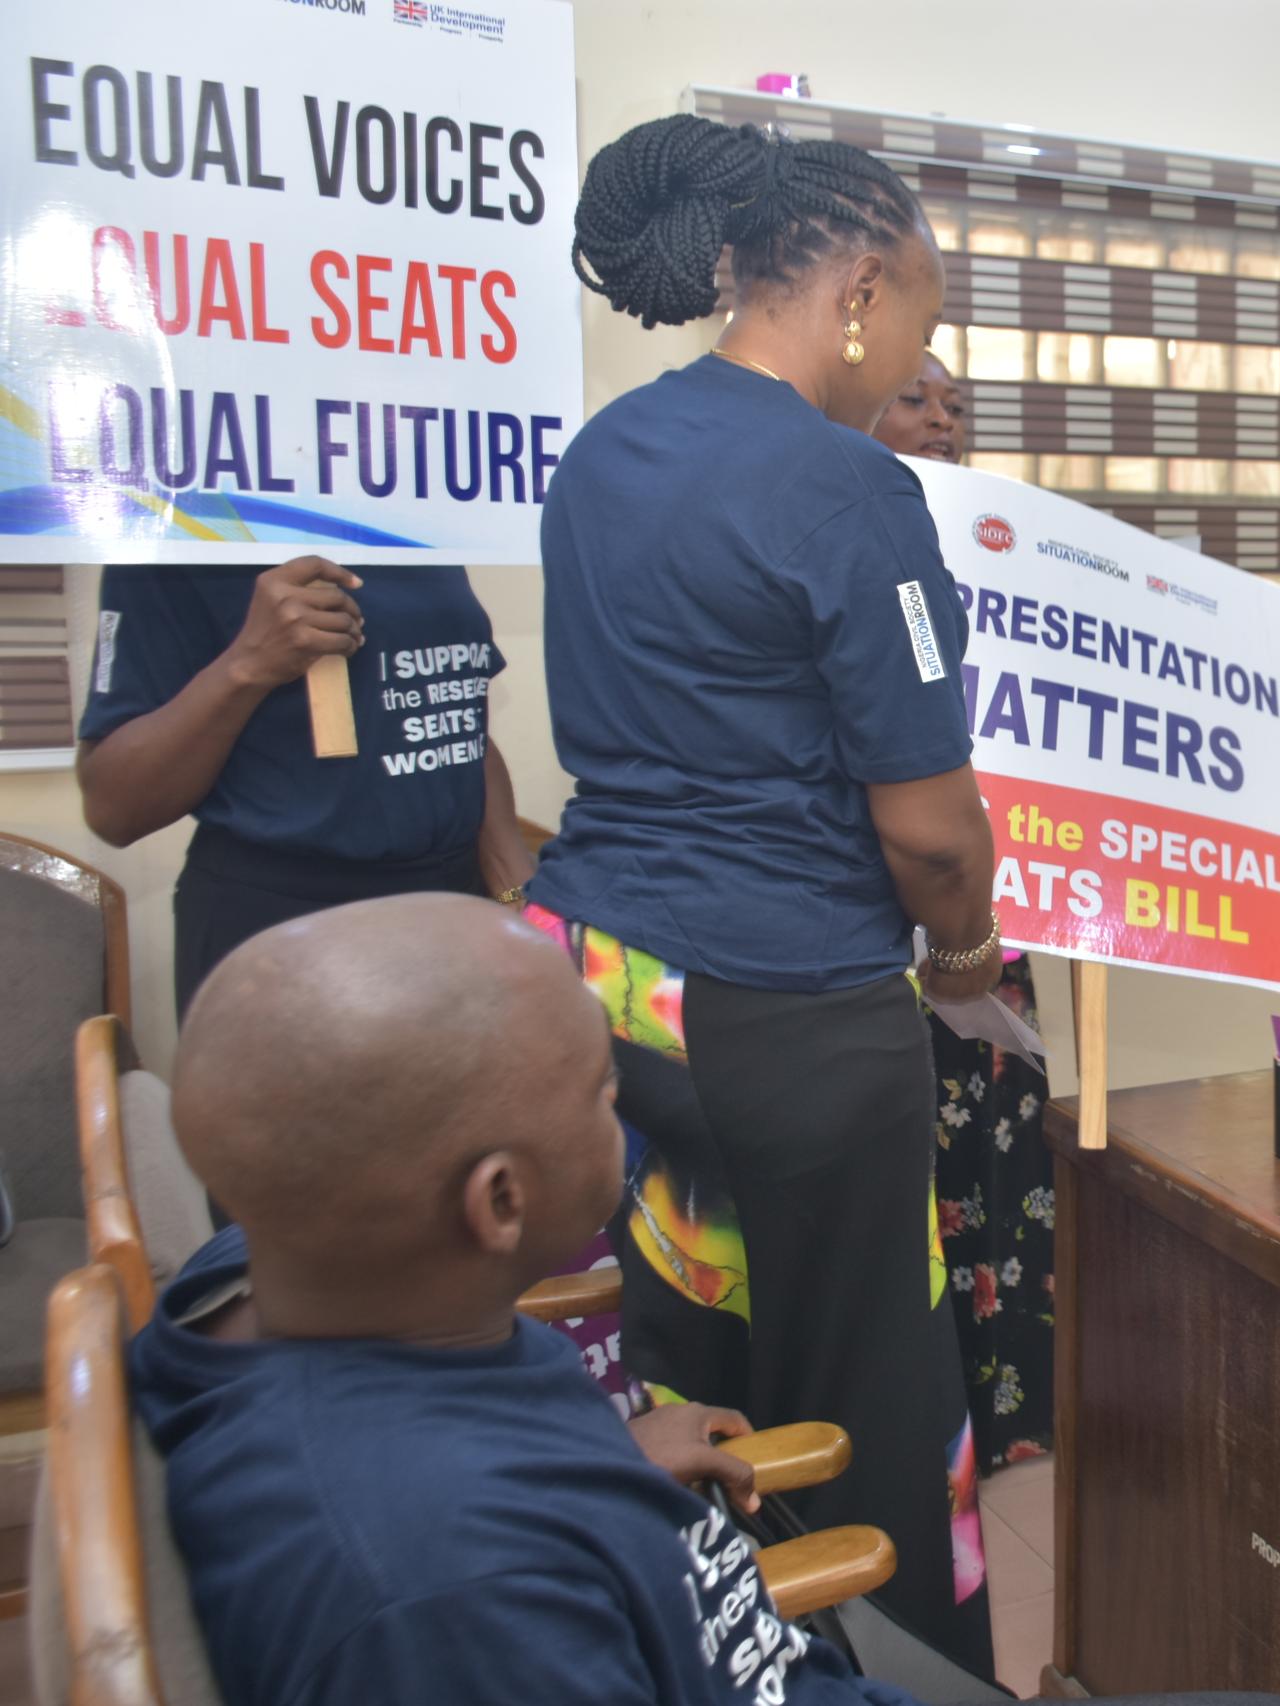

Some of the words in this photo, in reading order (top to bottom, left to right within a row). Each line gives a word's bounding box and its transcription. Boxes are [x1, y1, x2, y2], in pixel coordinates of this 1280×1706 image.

[430, 13, 504, 35] Development
[447, 7, 506, 26] International
[30, 56, 285, 192] EQUAL
[303, 94, 546, 226] VOICES
[45, 225, 290, 344] QUAL
[310, 249, 518, 364] SEATS
[316, 398, 562, 504] FUTURE
[1037, 541, 1129, 582] SITUATIONROOM
[906, 583, 941, 676] SITUATIONROOM
[954, 581, 1280, 719] RESENTATION
[380, 652, 387, 681] I
[382, 688, 422, 711] the
[403, 707, 476, 742] SEATS
[382, 738, 479, 776] WOMEN
[1007, 803, 1084, 852] the
[992, 855, 1103, 919] ATS
[1125, 878, 1250, 945] BILL
